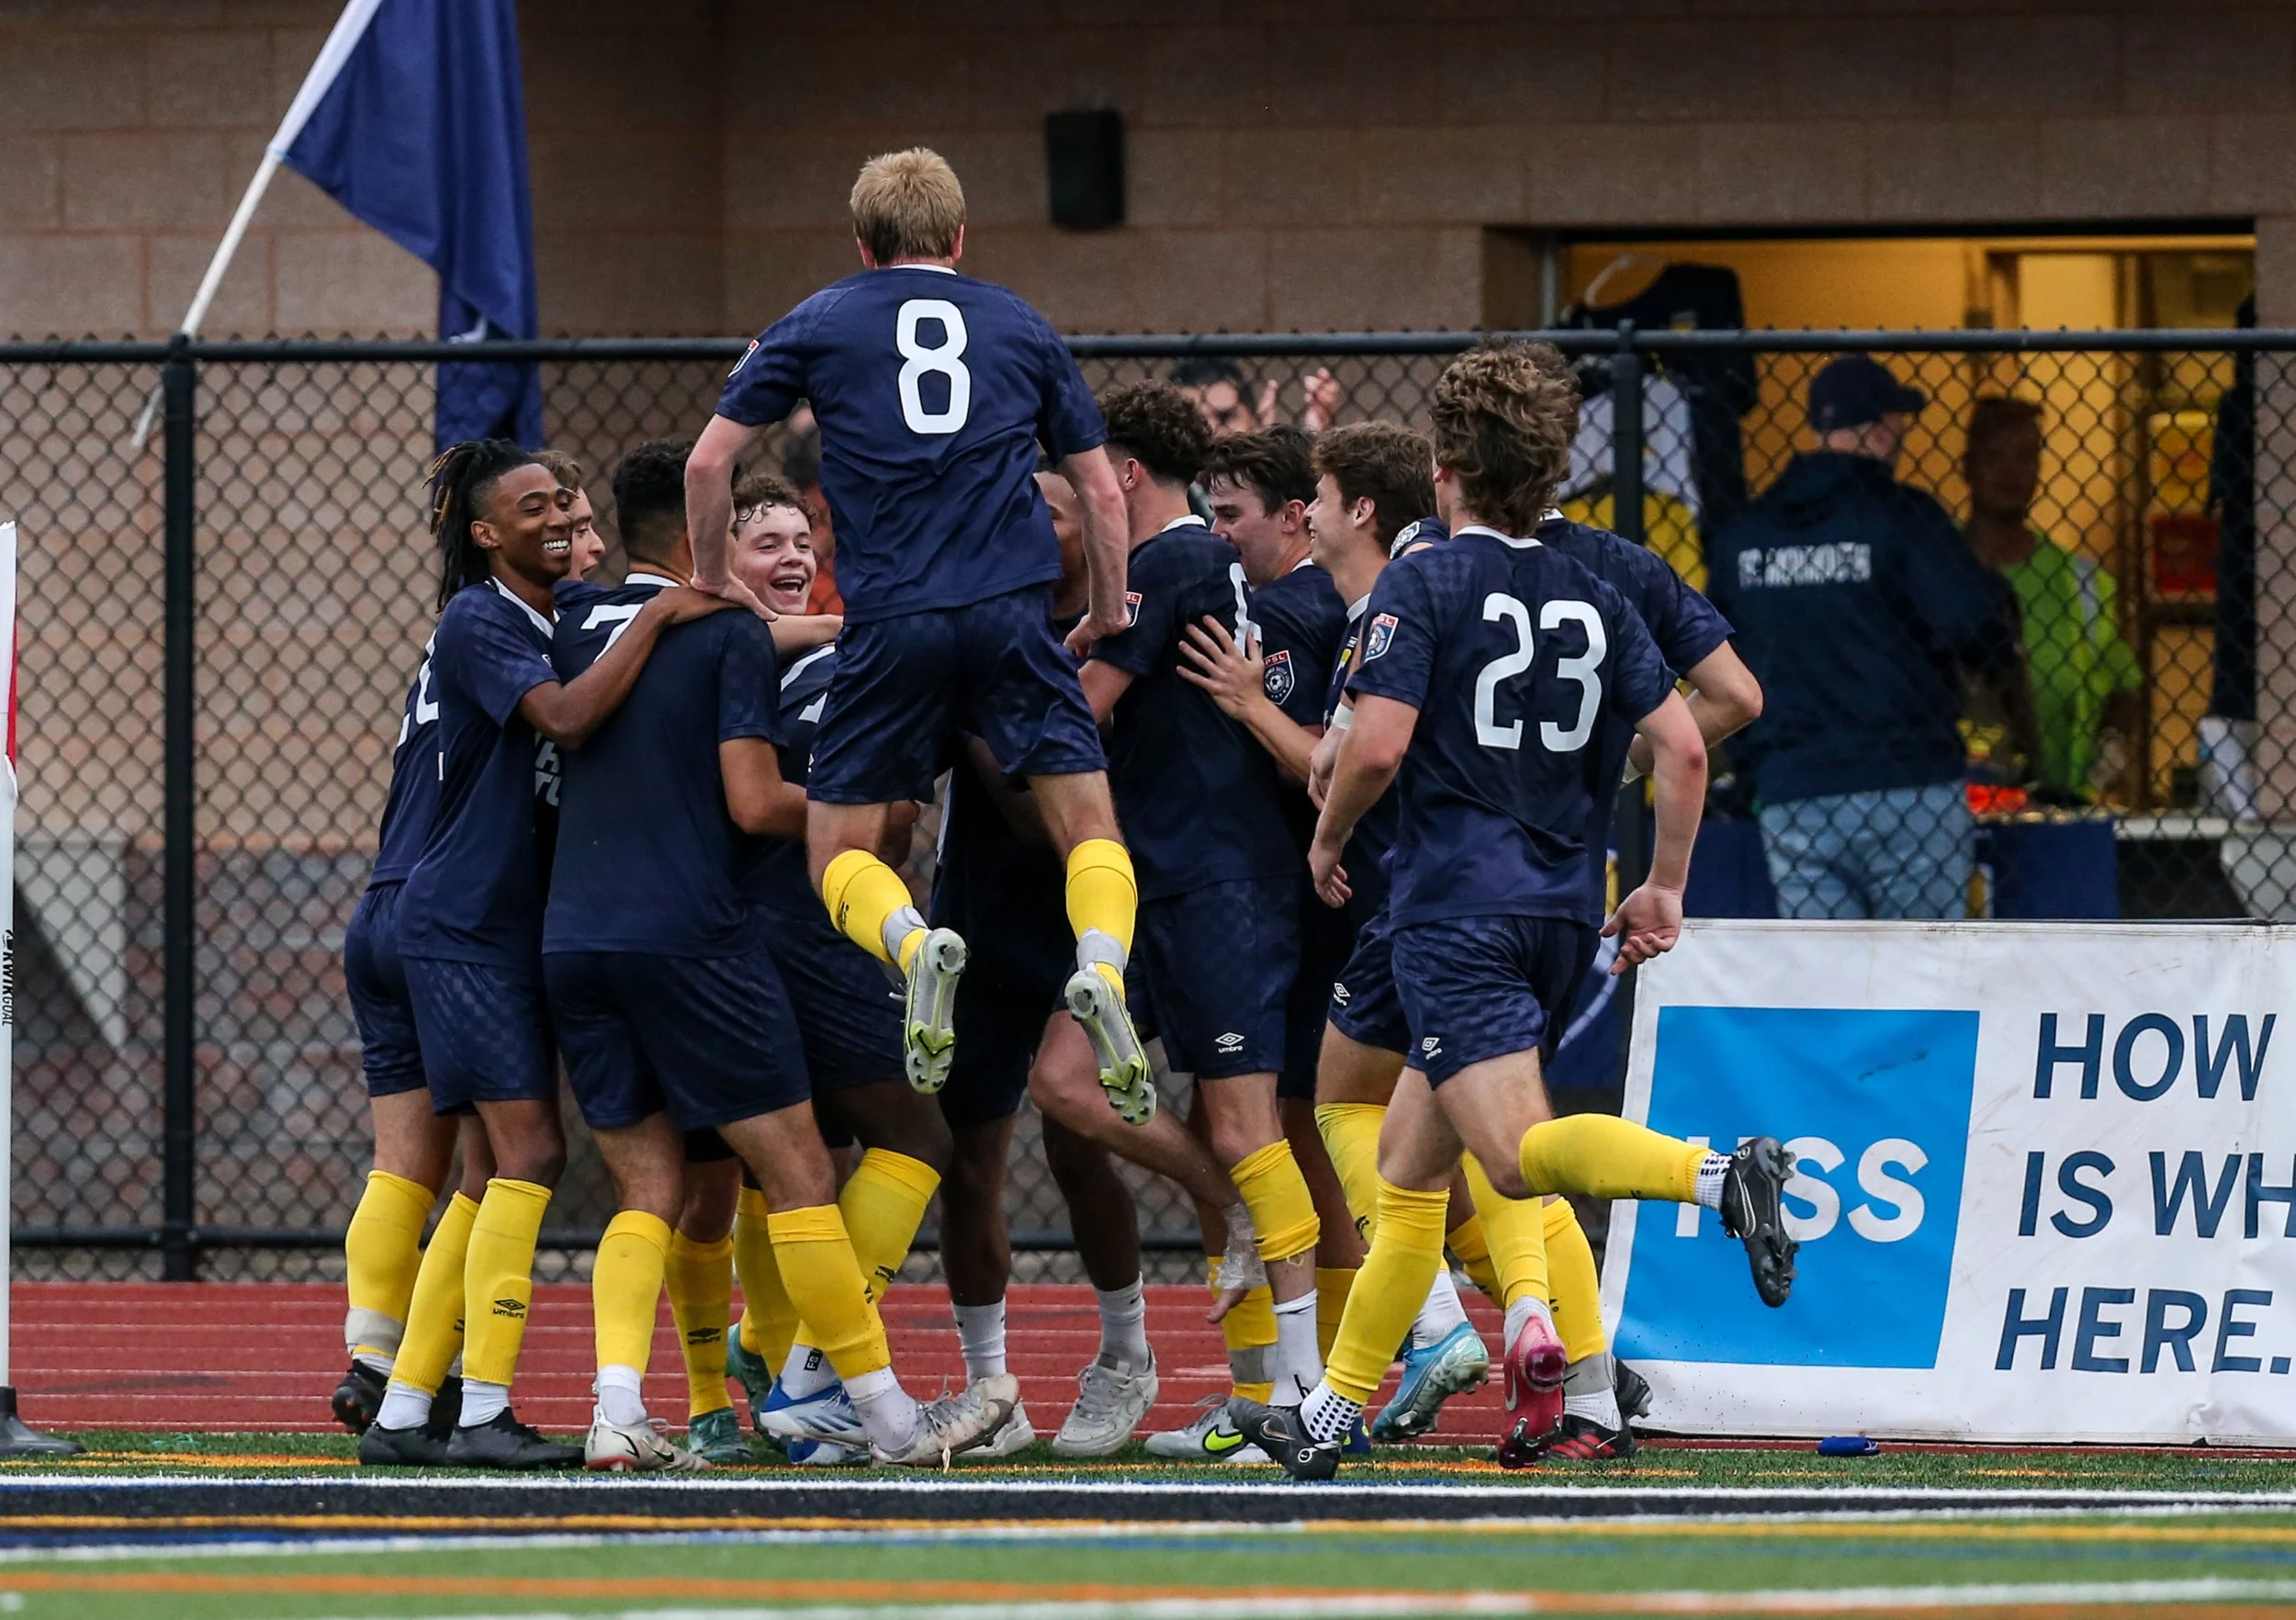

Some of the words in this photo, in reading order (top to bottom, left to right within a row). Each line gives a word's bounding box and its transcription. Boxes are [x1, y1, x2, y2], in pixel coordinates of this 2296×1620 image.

[896, 299, 971, 433] 8
[1474, 592, 1607, 752] 23
[2032, 1012, 2278, 1102] HOW
[2018, 1150, 2116, 1239] IS
[1994, 1286, 2292, 1375] HERE.
